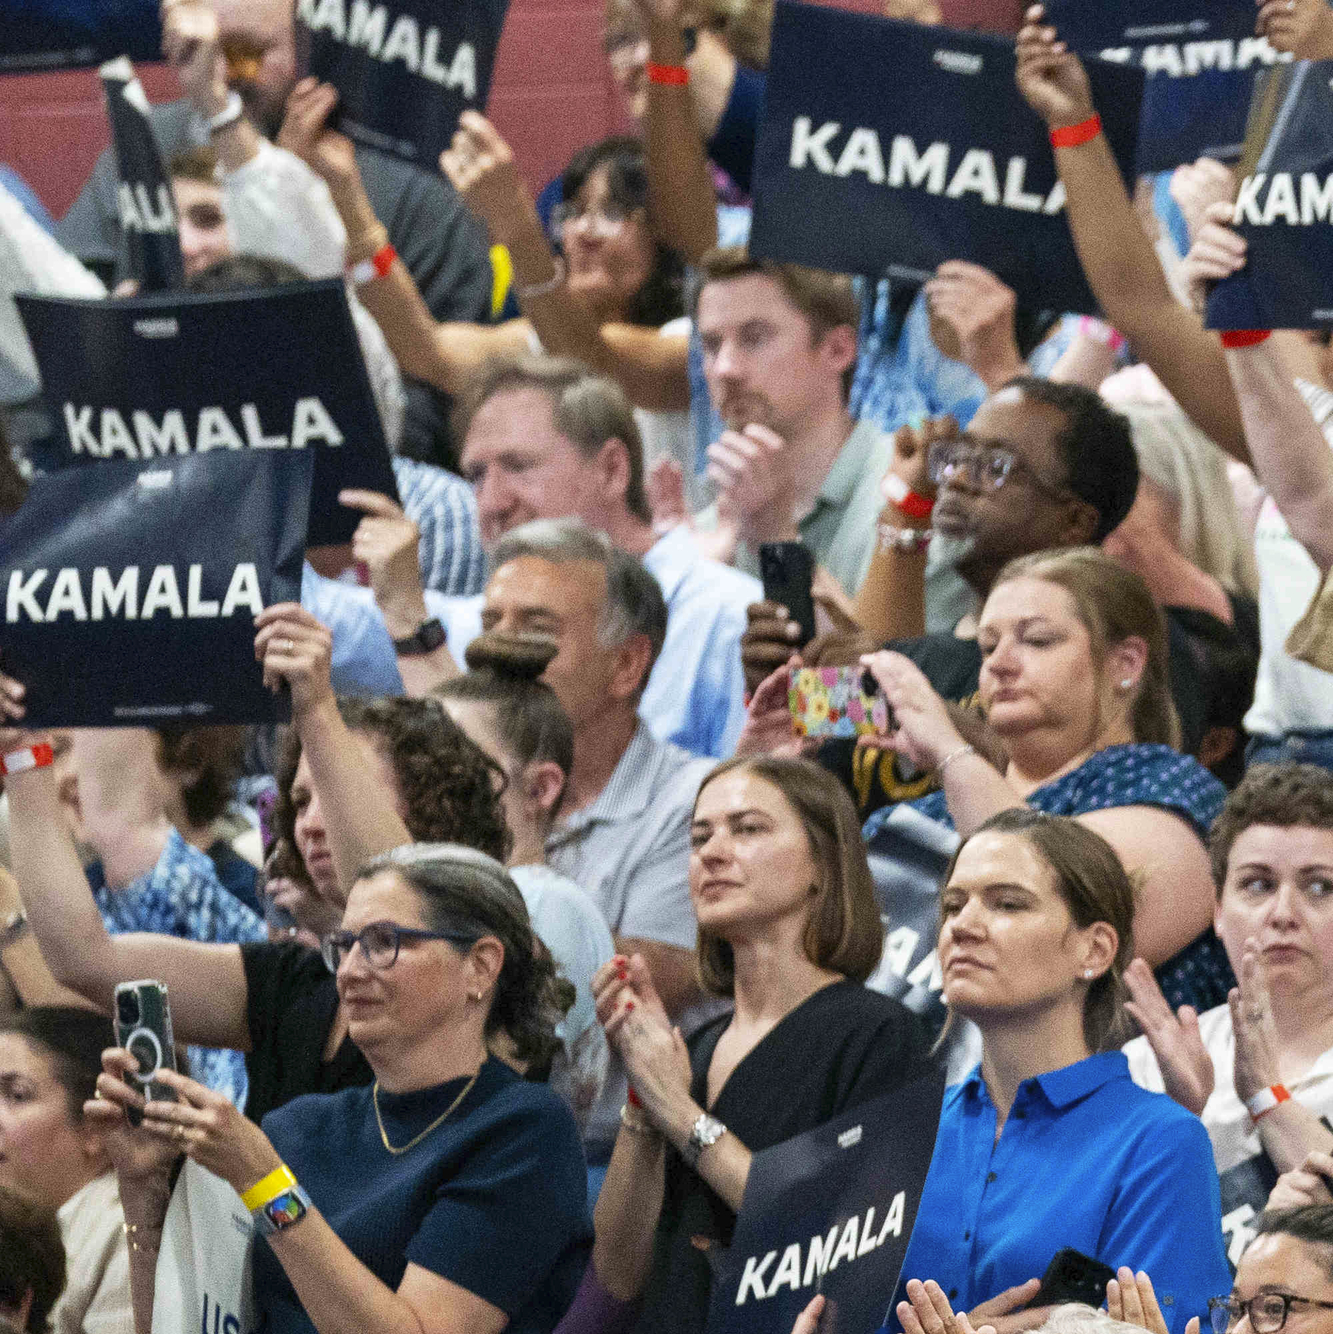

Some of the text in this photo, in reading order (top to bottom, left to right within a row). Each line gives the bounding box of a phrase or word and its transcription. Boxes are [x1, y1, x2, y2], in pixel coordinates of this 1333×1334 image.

[64, 398, 344, 458] KAMALA
[6, 562, 262, 622] KAMALA
[736, 1190, 905, 1306] KAMALA
